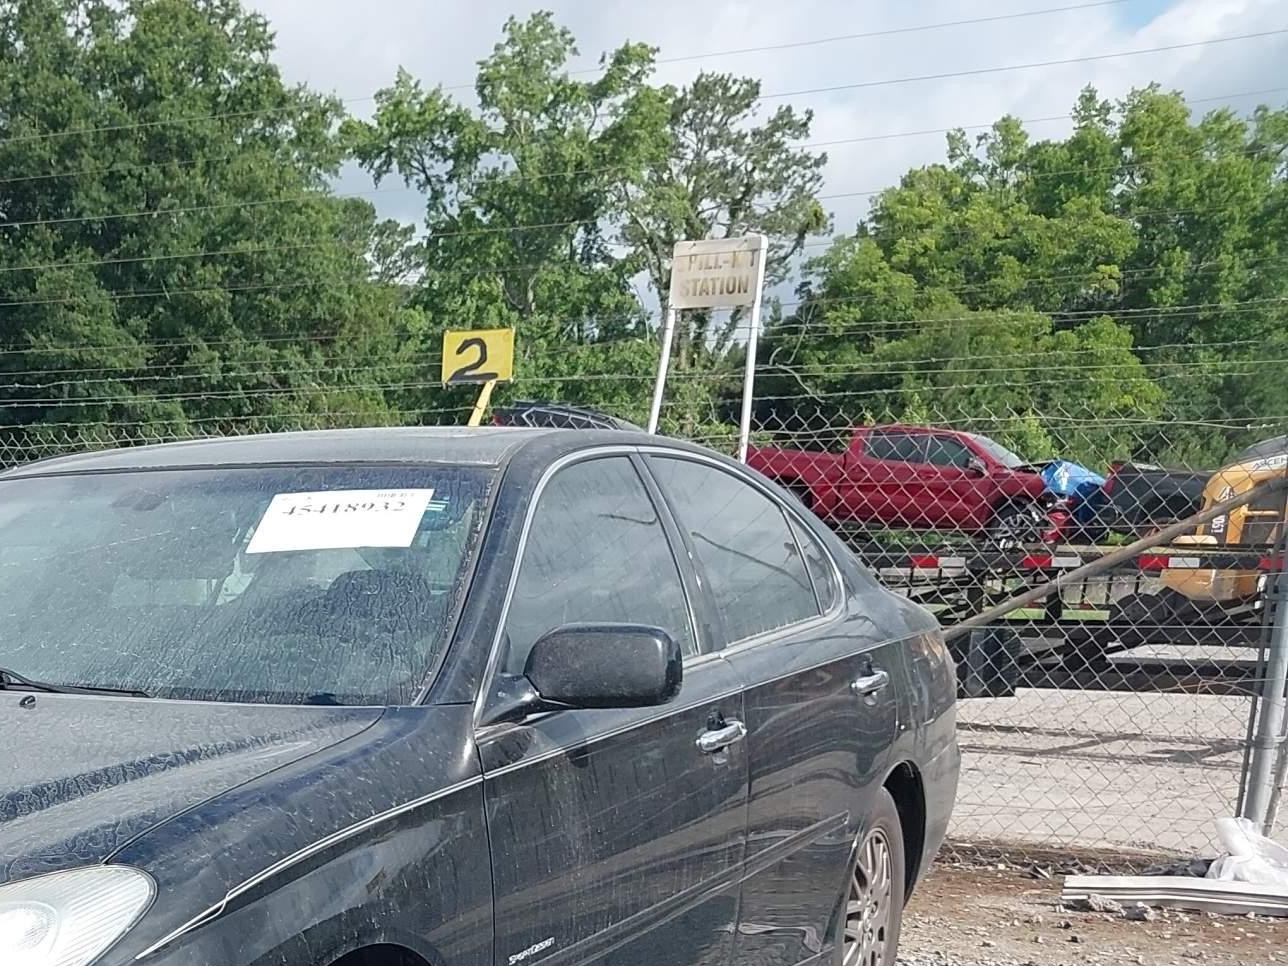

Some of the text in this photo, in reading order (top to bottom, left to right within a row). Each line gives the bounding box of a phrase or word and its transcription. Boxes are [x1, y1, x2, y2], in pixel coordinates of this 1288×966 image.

[679, 275, 750, 297] STATION
[447, 337, 499, 382] 2
[281, 501, 406, 516] 45418932
